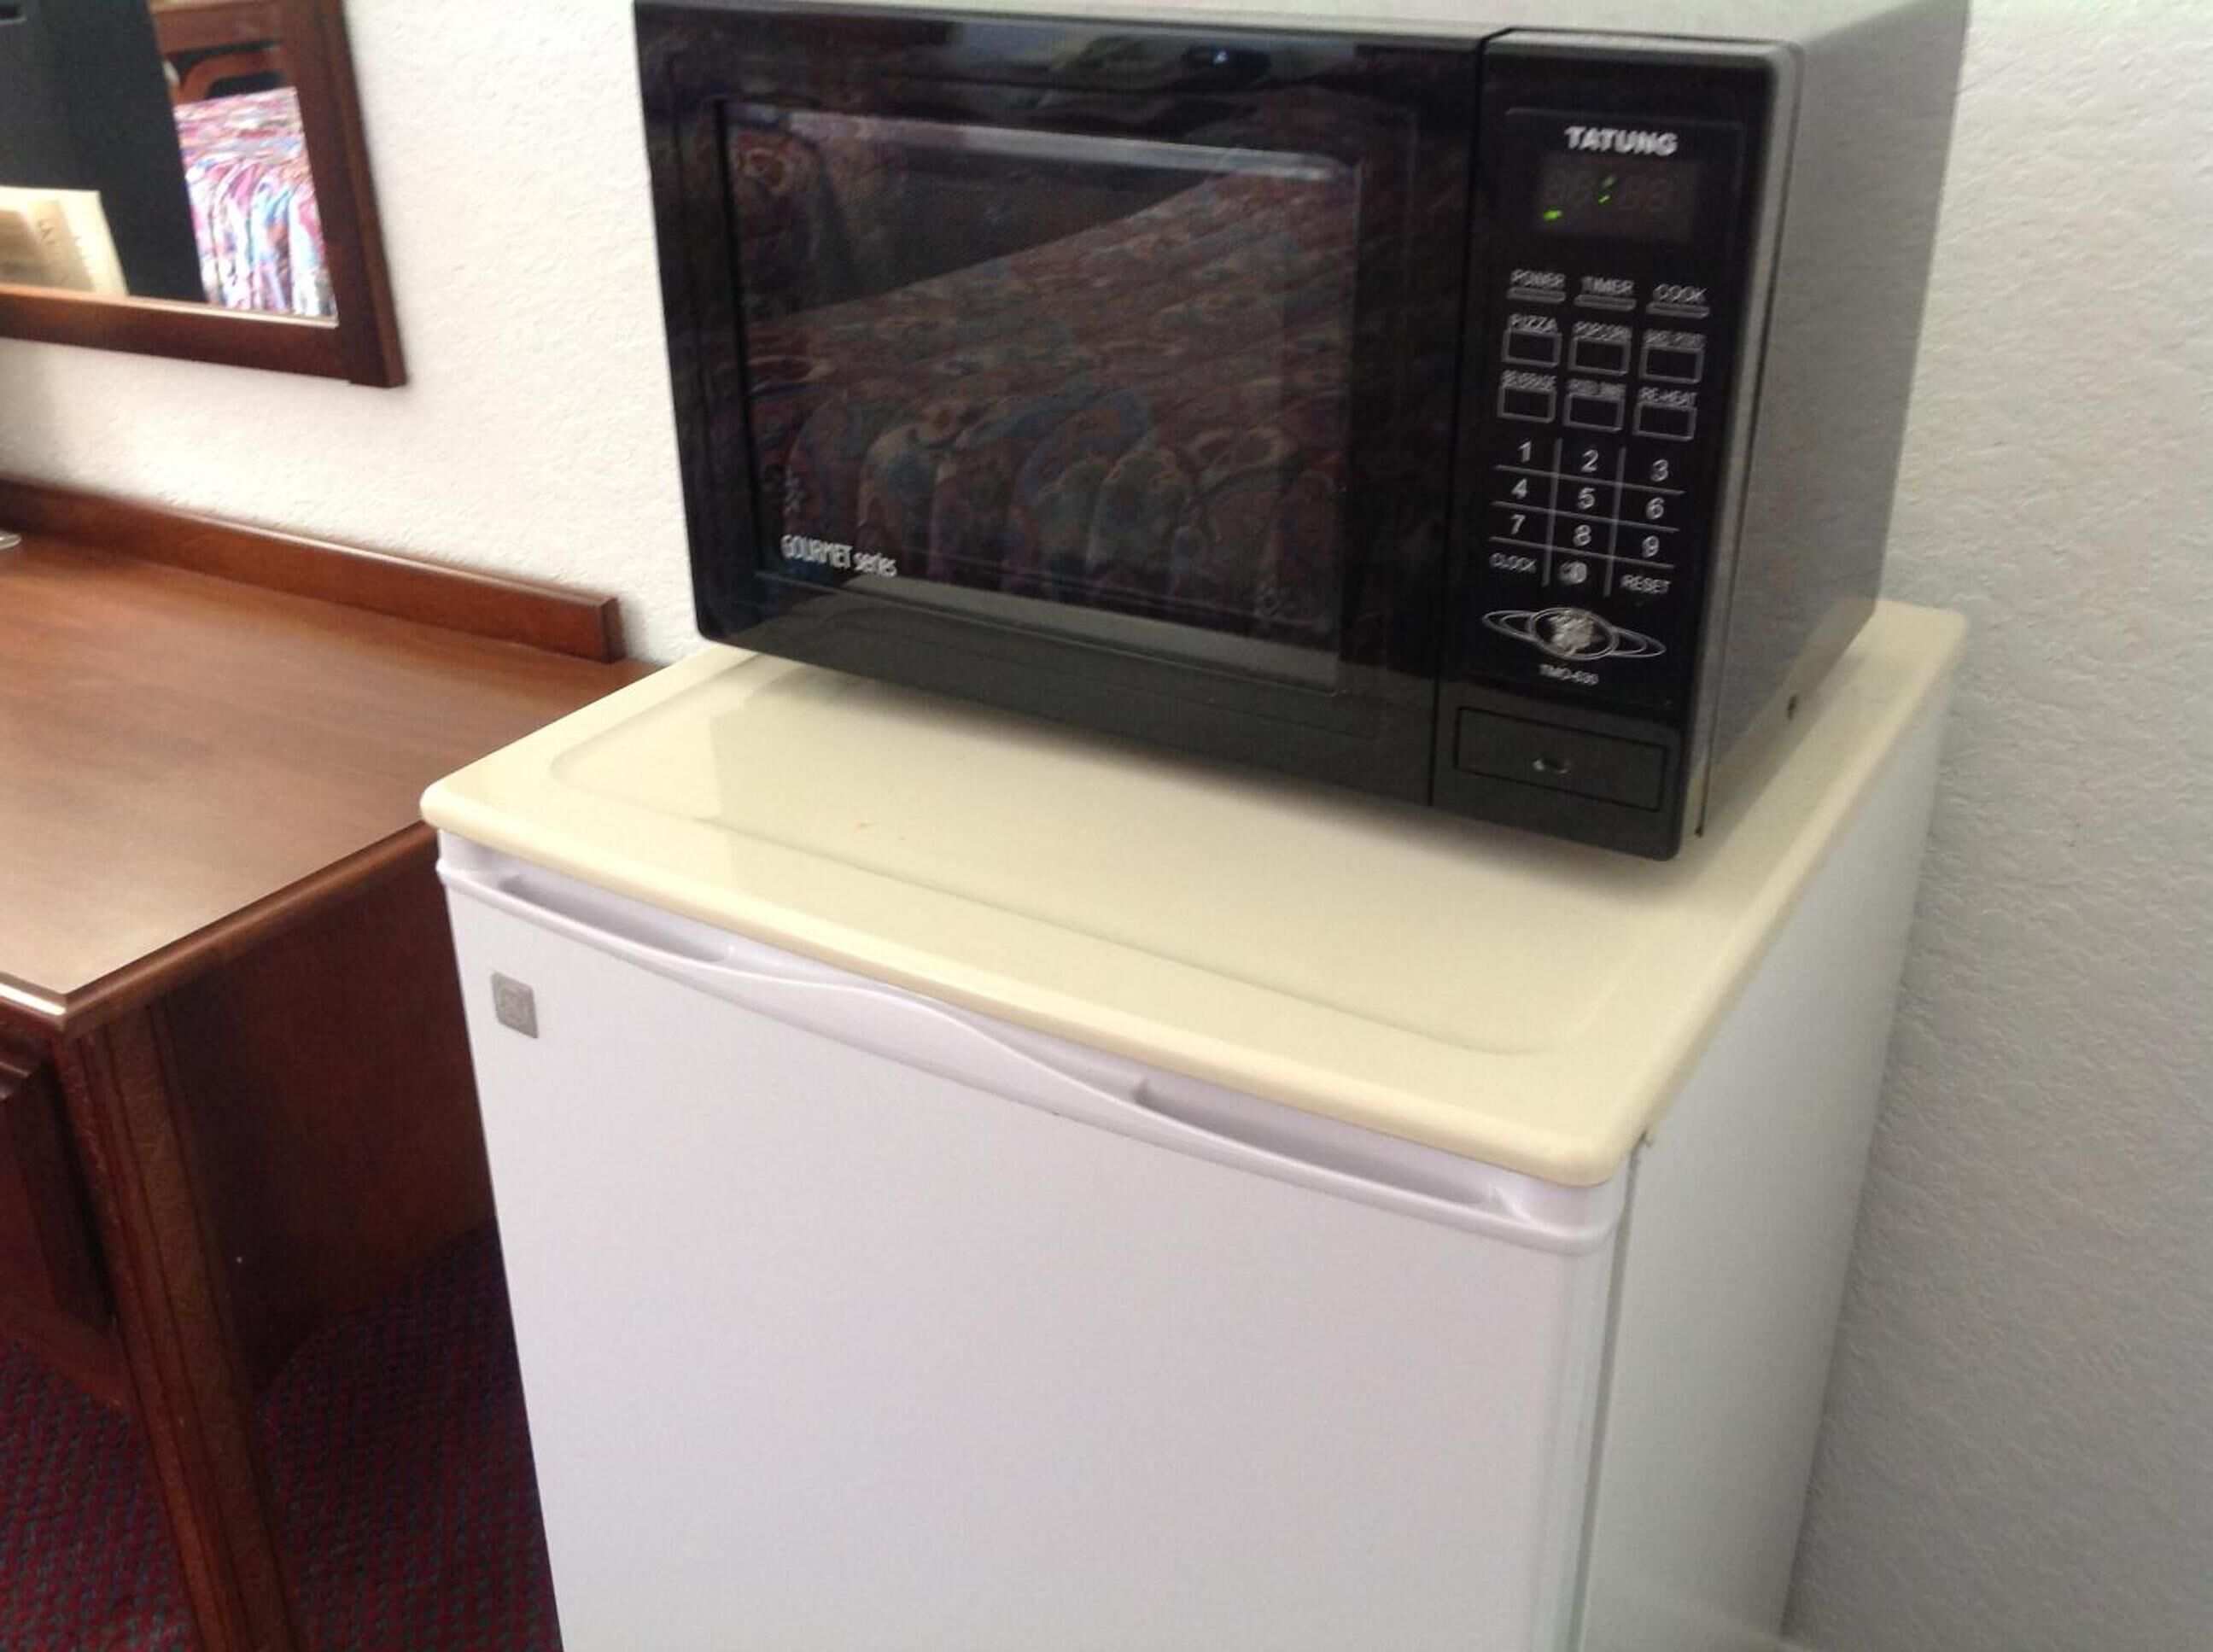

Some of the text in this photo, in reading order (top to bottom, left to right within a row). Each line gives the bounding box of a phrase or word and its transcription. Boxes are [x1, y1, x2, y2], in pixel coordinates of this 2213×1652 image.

[1564, 126, 1679, 156] TATUNG
[1508, 312, 1558, 333] PIZZA
[1518, 441, 1533, 463] 1
[1581, 449, 1599, 473] 2
[1650, 458, 1670, 482] 3
[1510, 478, 1529, 499] 4
[1577, 487, 1596, 510] 5
[1646, 497, 1665, 520] 6
[1510, 514, 1527, 535] 7
[1574, 524, 1592, 546] 8
[780, 534, 853, 569] GOURMET
[1642, 535, 1661, 558] 9
[1620, 574, 1672, 595] RESET
